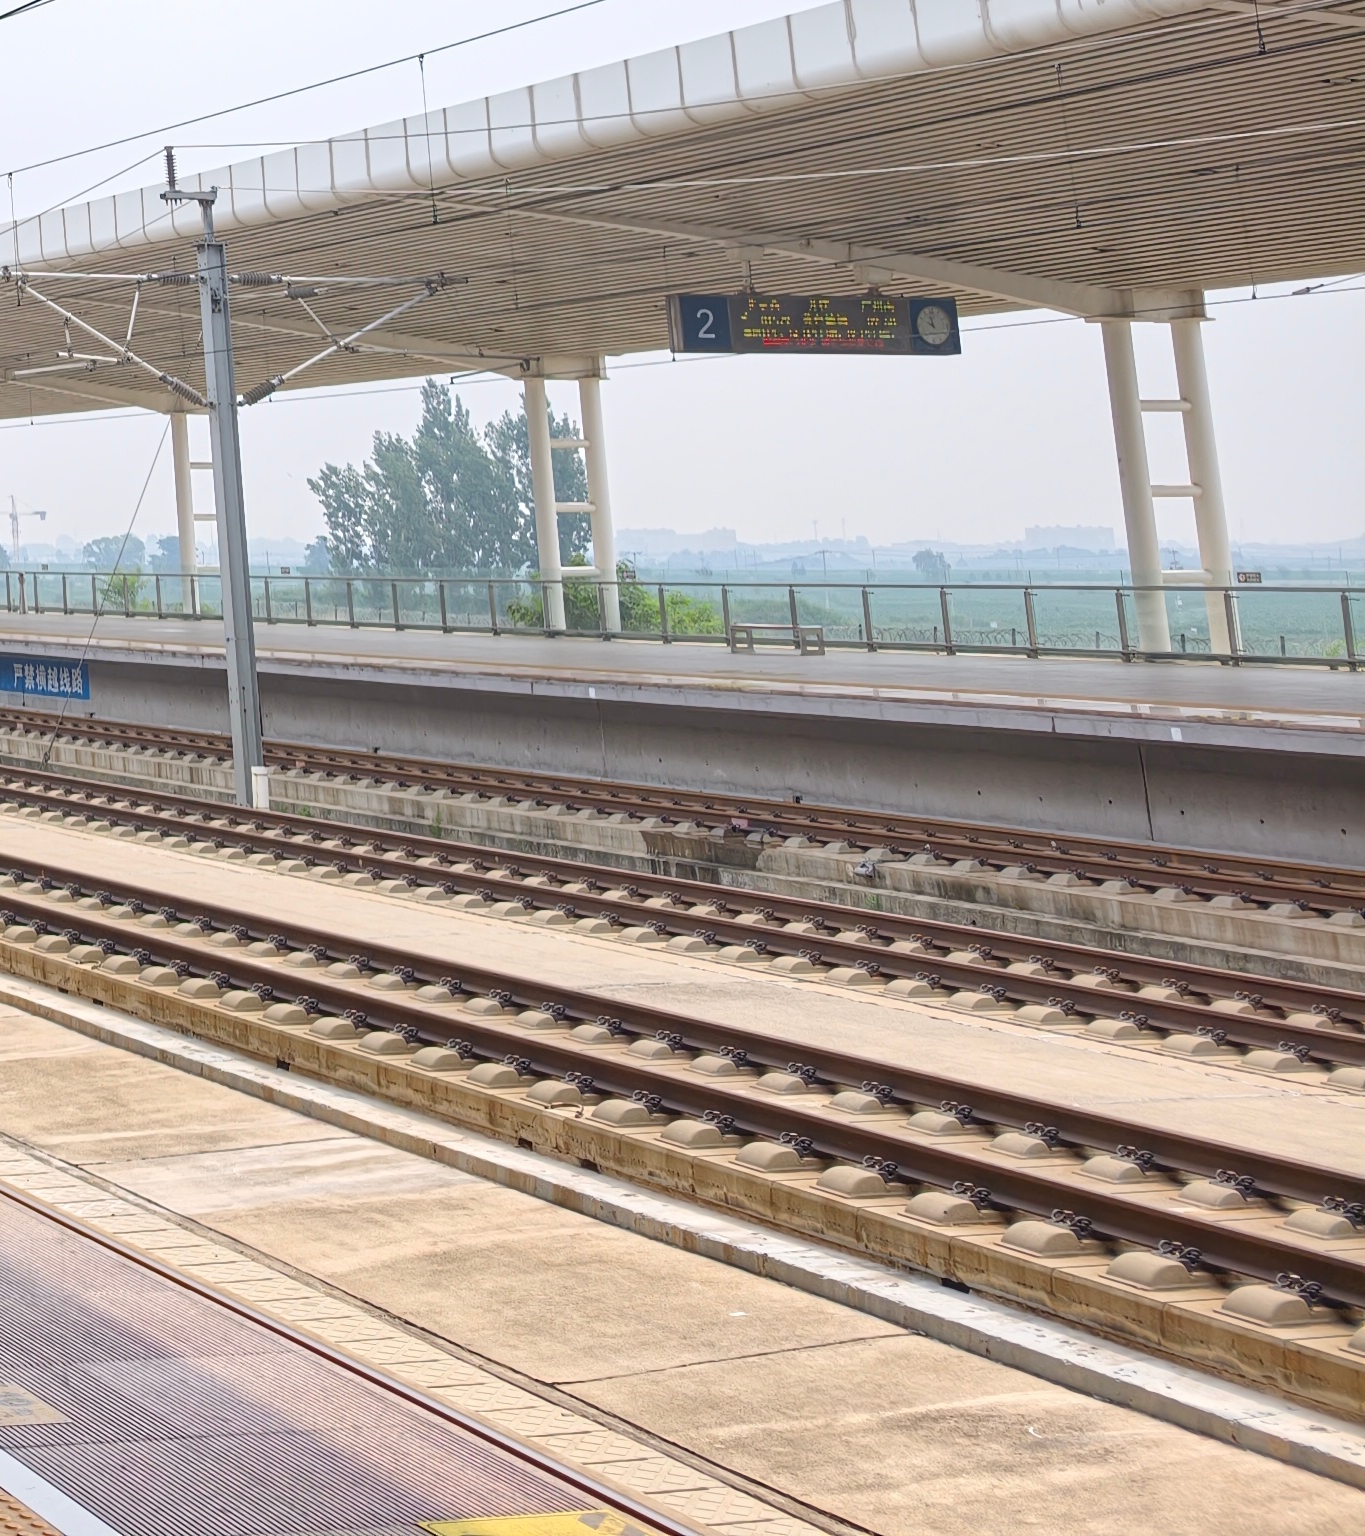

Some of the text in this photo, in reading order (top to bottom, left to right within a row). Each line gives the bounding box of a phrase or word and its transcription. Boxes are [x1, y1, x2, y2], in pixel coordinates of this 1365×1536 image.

[696, 308, 716, 339] 2
[13, 663, 83, 695] 严禁横越线路
